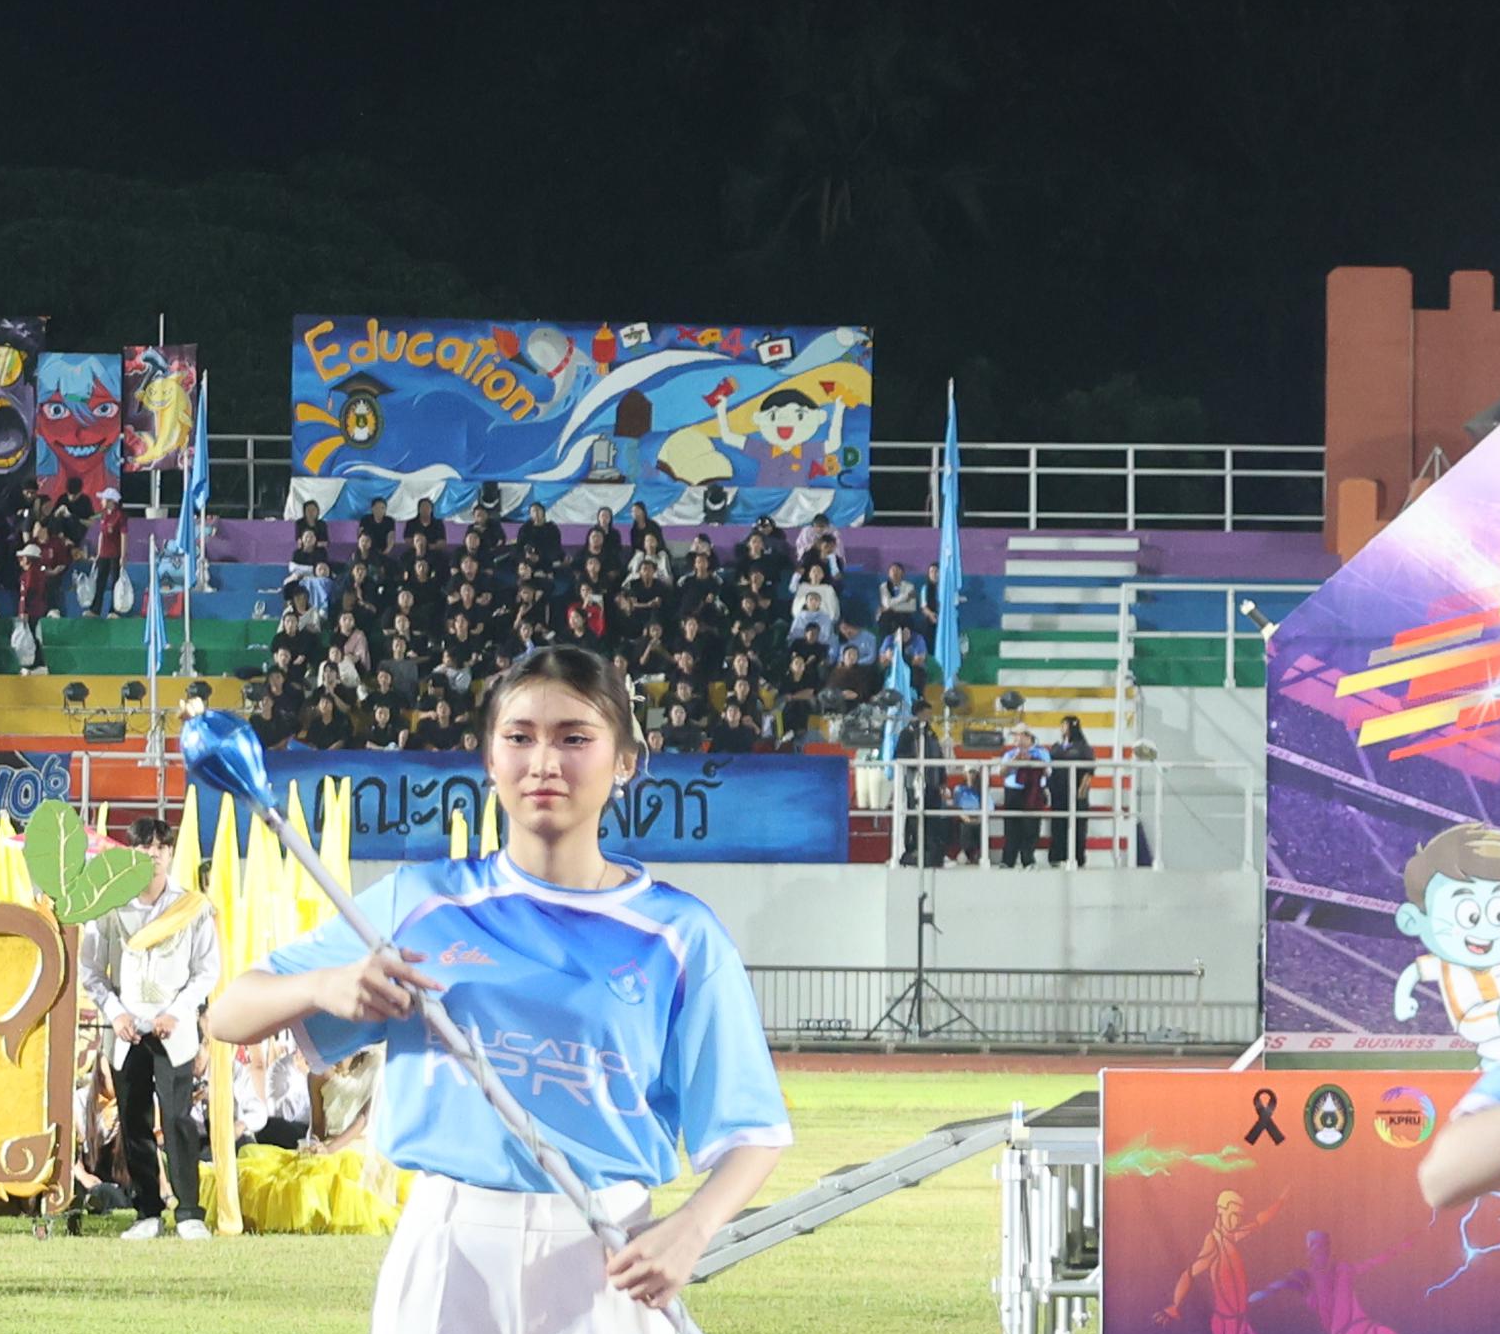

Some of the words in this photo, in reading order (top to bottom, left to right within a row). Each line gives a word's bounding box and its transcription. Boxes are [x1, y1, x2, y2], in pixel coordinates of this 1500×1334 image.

[303, 318, 541, 422] Education
[1353, 1037, 1436, 1049] BUSINESS
[1389, 1116, 1420, 1126] KPRU
